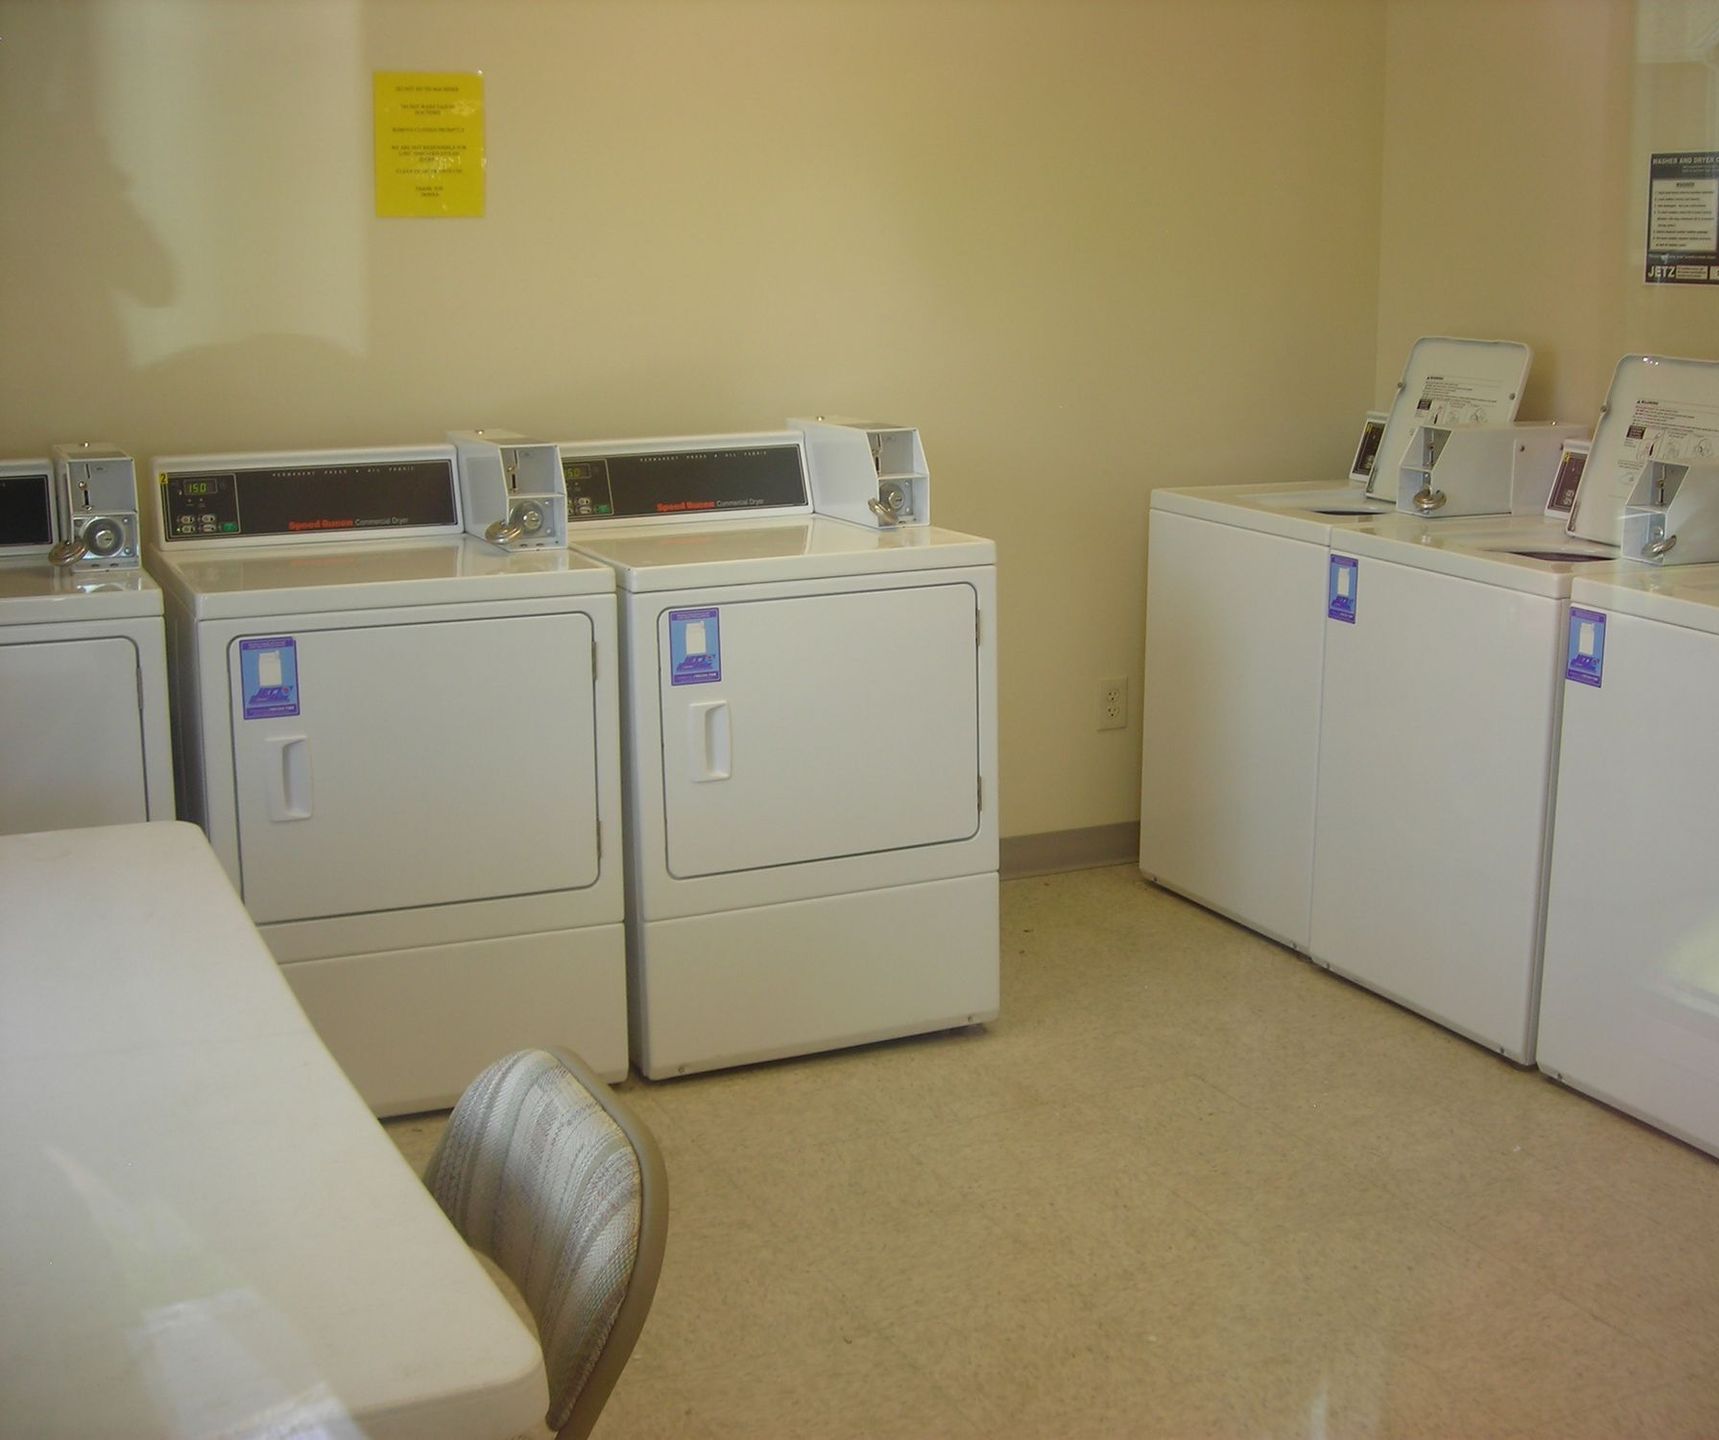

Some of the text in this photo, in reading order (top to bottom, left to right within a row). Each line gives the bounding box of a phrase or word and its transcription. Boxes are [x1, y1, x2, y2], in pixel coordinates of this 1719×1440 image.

[1648, 265, 1676, 278] JETZ
[748, 497, 765, 506] Dryer
[288, 520, 320, 531] Speed
[391, 516, 409, 526] Dryer
